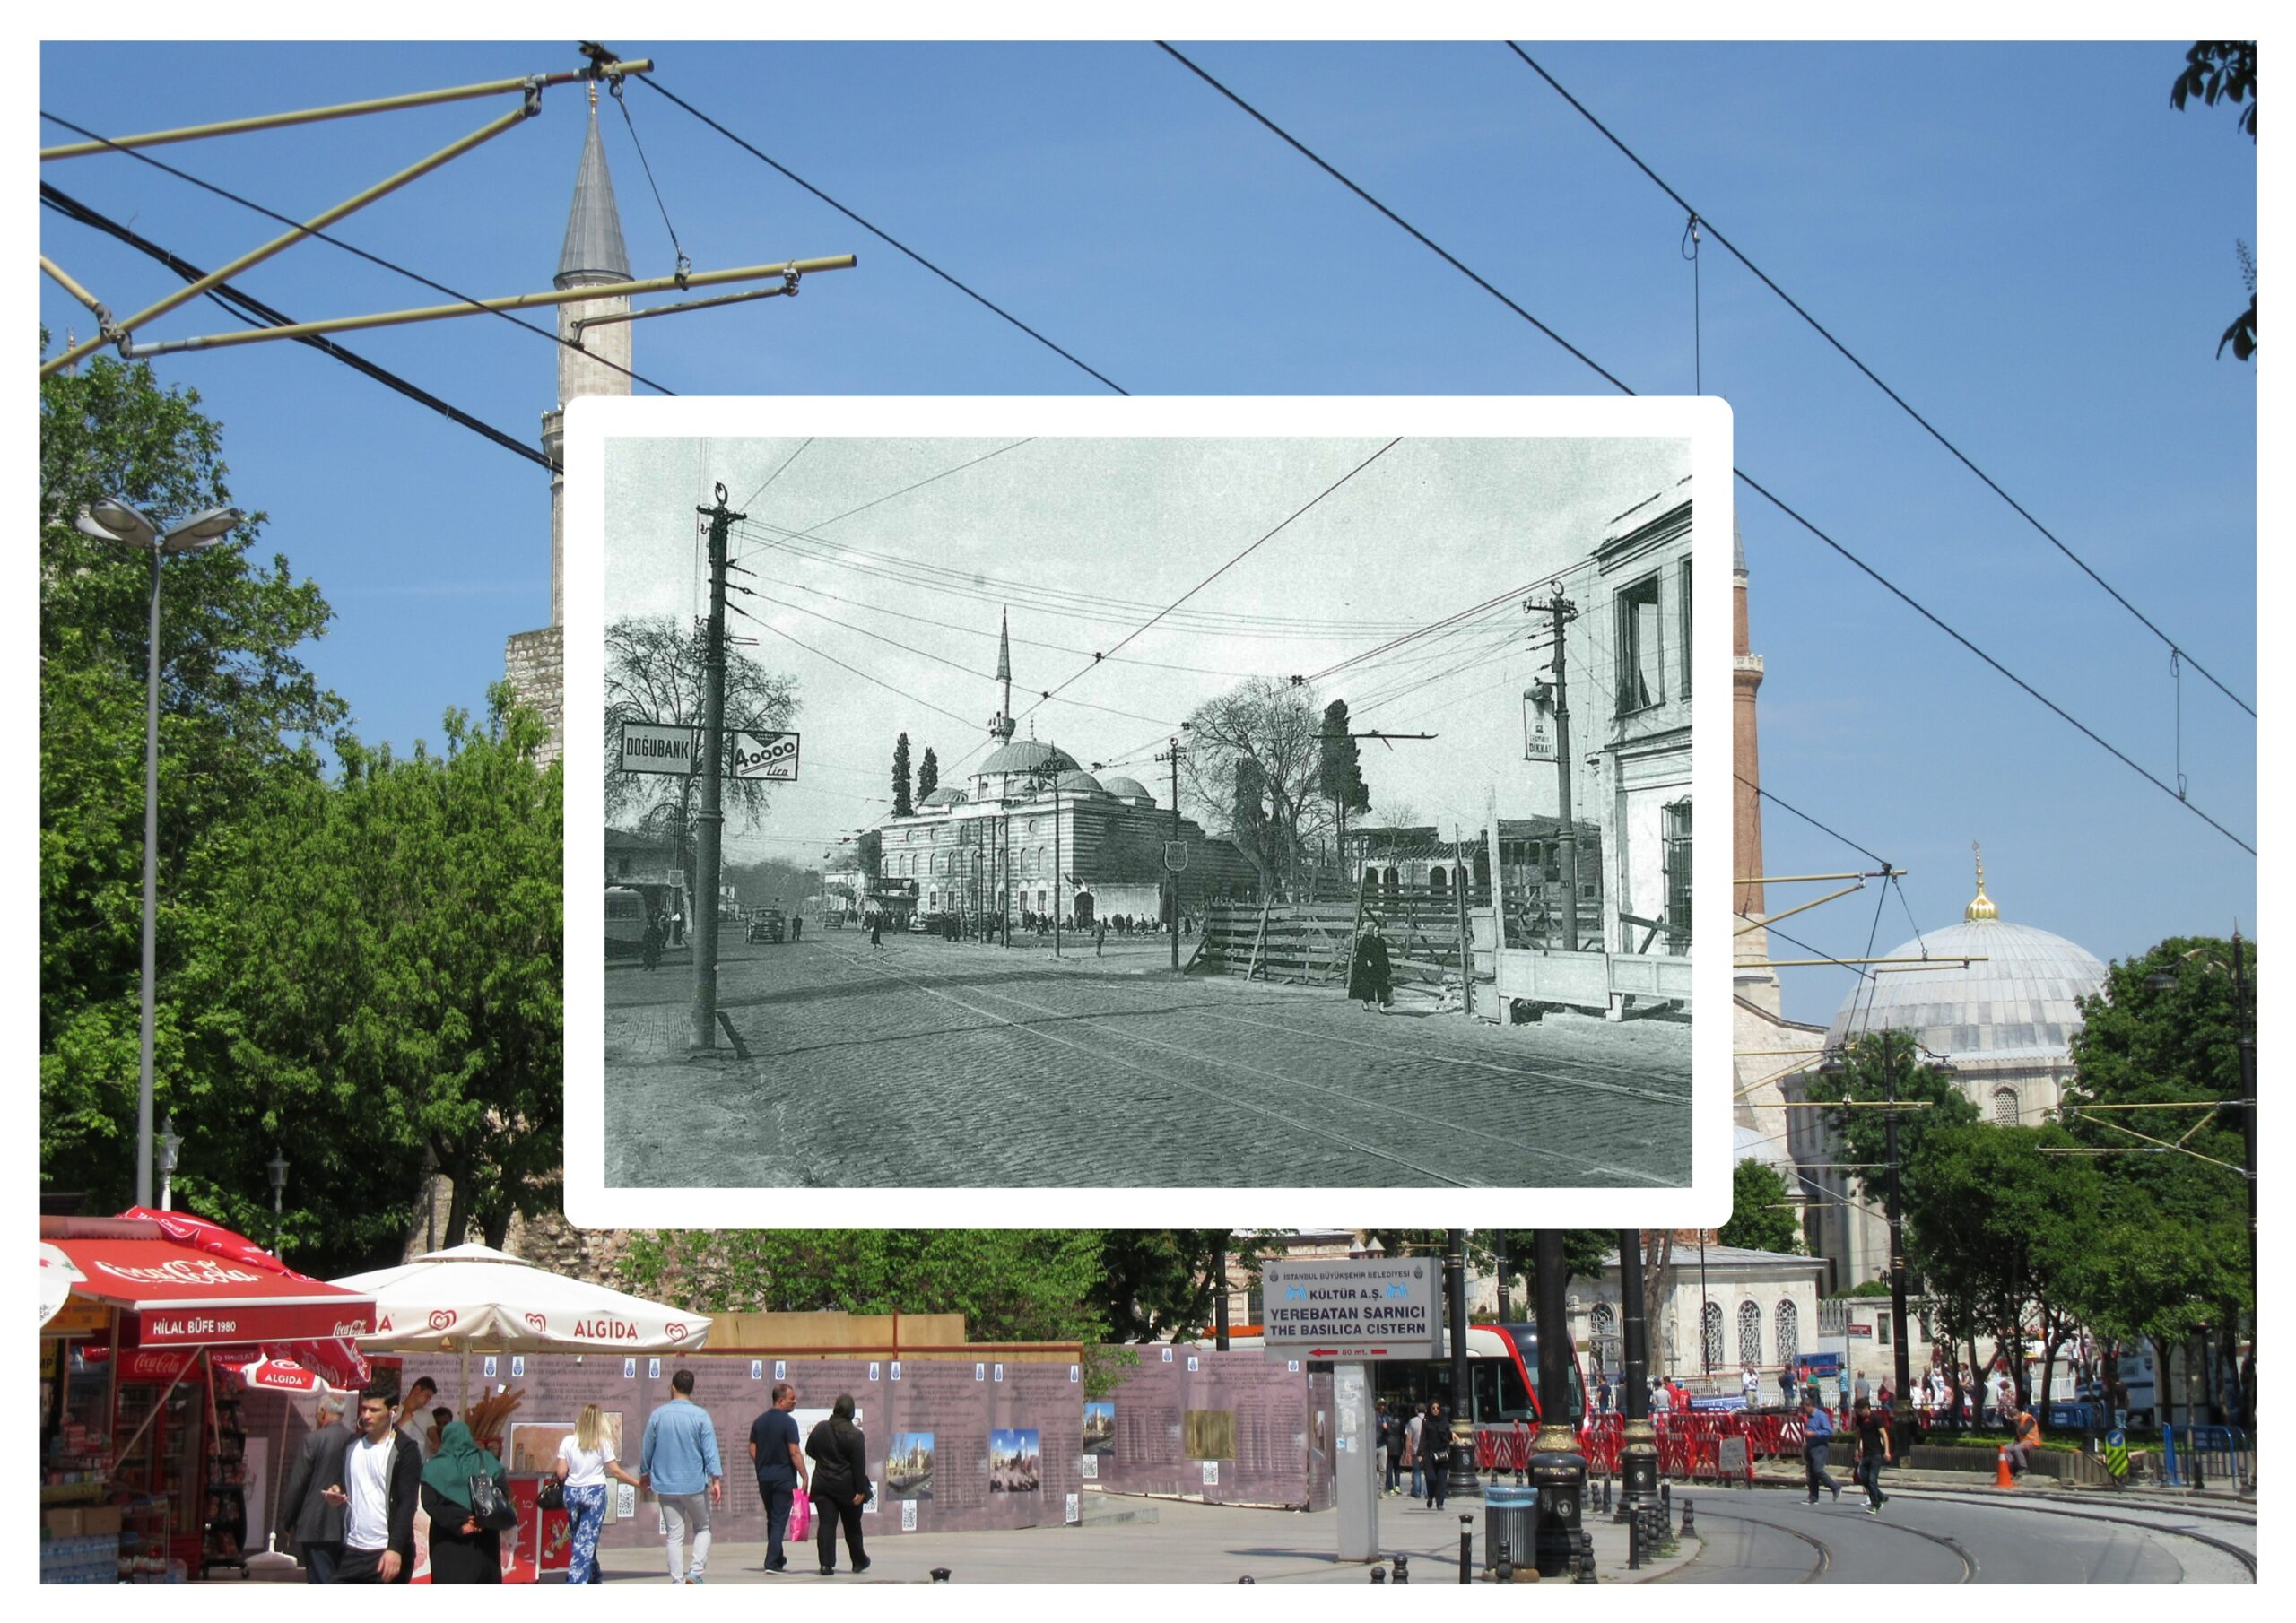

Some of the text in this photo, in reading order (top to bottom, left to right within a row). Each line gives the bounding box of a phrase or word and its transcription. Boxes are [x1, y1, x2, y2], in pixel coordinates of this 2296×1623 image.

[626, 735, 690, 759] DOĞUBANK
[735, 742, 796, 768] 40000
[767, 759, 789, 777] Lira
[94, 1260, 263, 1284] Coca-Cola
[1283, 1269, 1411, 1281] İSTANBUL BÜYÜKŞEHİR BELEDİYESİ
[1309, 1289, 1383, 1301] KÜLTÜR A.Ş.
[1270, 1306, 1426, 1321] YEREBATAN SARNICI
[153, 1317, 237, 1335] HİLAL BÜFE 1980
[1270, 1323, 1426, 1336] THE BASILICA CISTERN
[265, 1374, 303, 1385] ALGIDA
